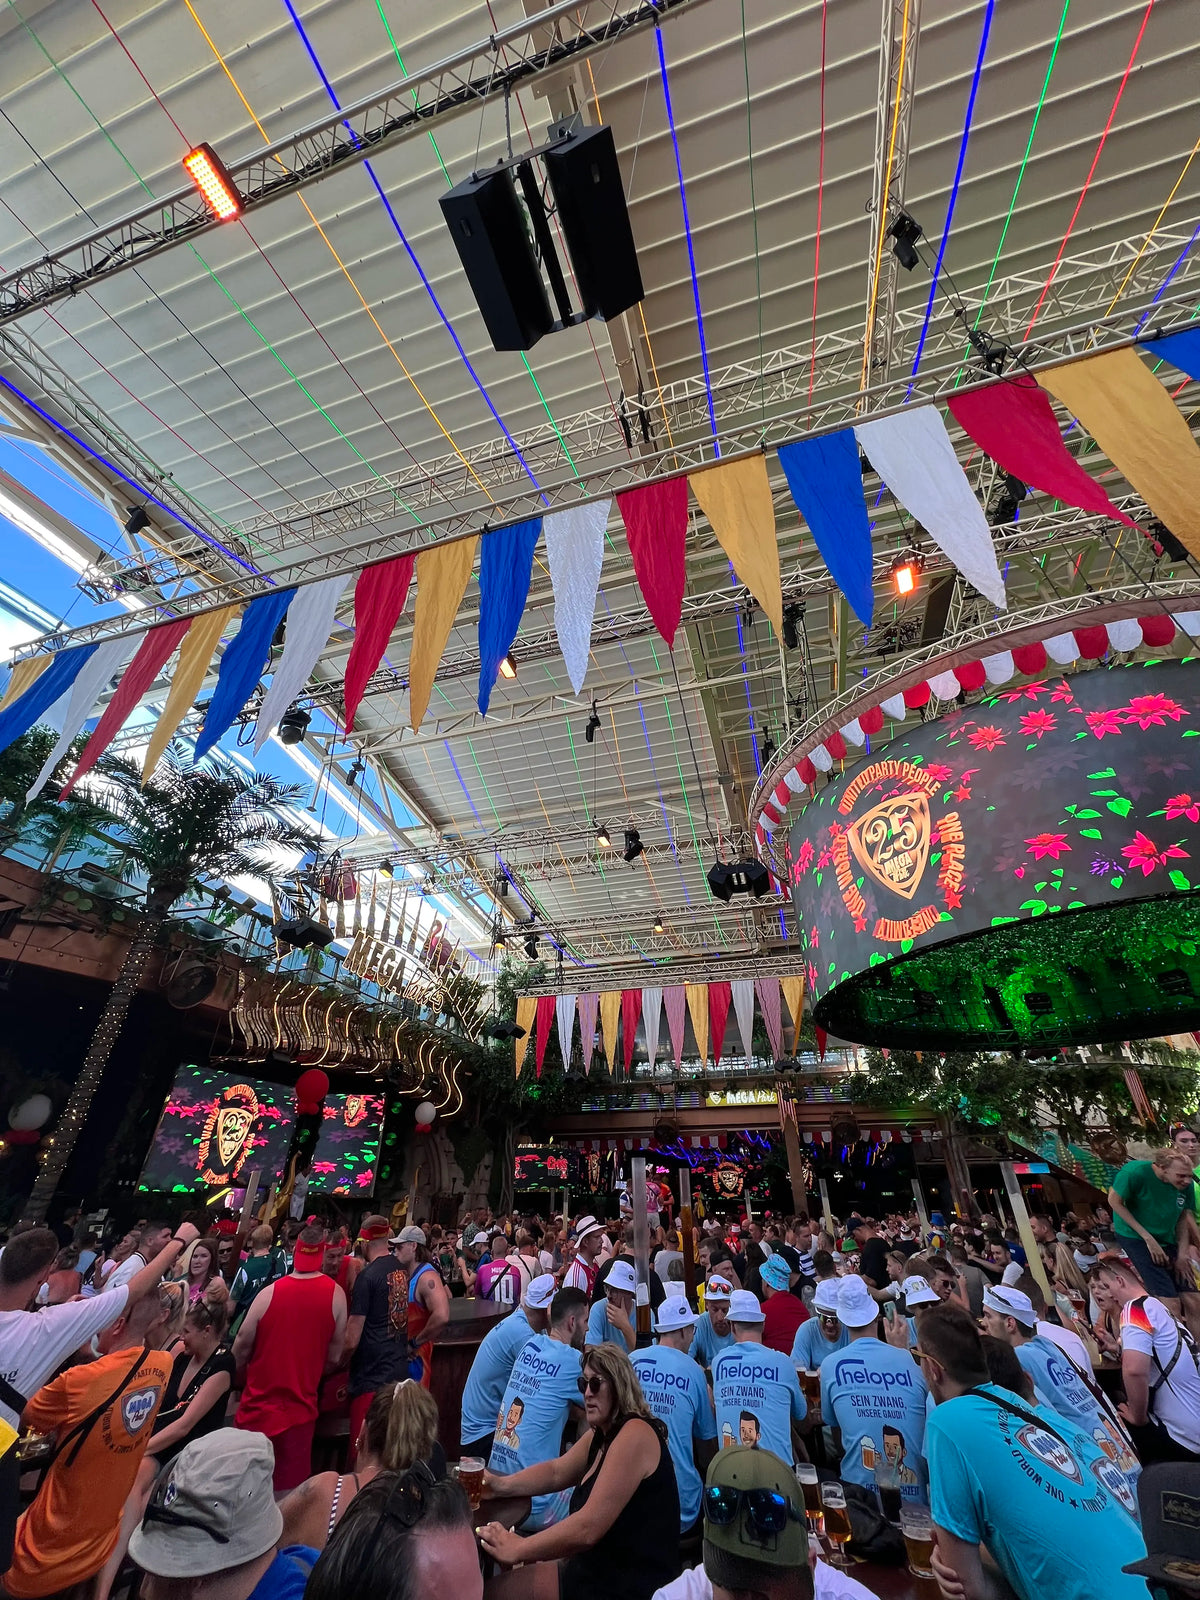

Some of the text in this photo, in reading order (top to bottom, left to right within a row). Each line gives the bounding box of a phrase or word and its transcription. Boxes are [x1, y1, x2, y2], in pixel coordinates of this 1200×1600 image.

[838, 760, 943, 815] UNITED PARTY PEOPLE
[865, 806, 918, 864] 25
[884, 851, 913, 875] MEGA
[937, 811, 966, 893] ONE PLACE
[342, 930, 428, 1005] MEGA Park
[726, 1089, 776, 1104] MEGA Park
[490, 1274, 514, 1304] 10
[133, 1367, 152, 1381] PARTY
[520, 1373, 541, 1392] ZWANG,
[648, 1390, 677, 1408] ZWANG,
[720, 1385, 767, 1400] SEIN ZWANG,
[850, 1394, 908, 1410] SEIN ZWANG,
[856, 1408, 882, 1418] UNSERE
[1011, 1449, 1043, 1487] WORLD
[1043, 1480, 1065, 1503] ONE
